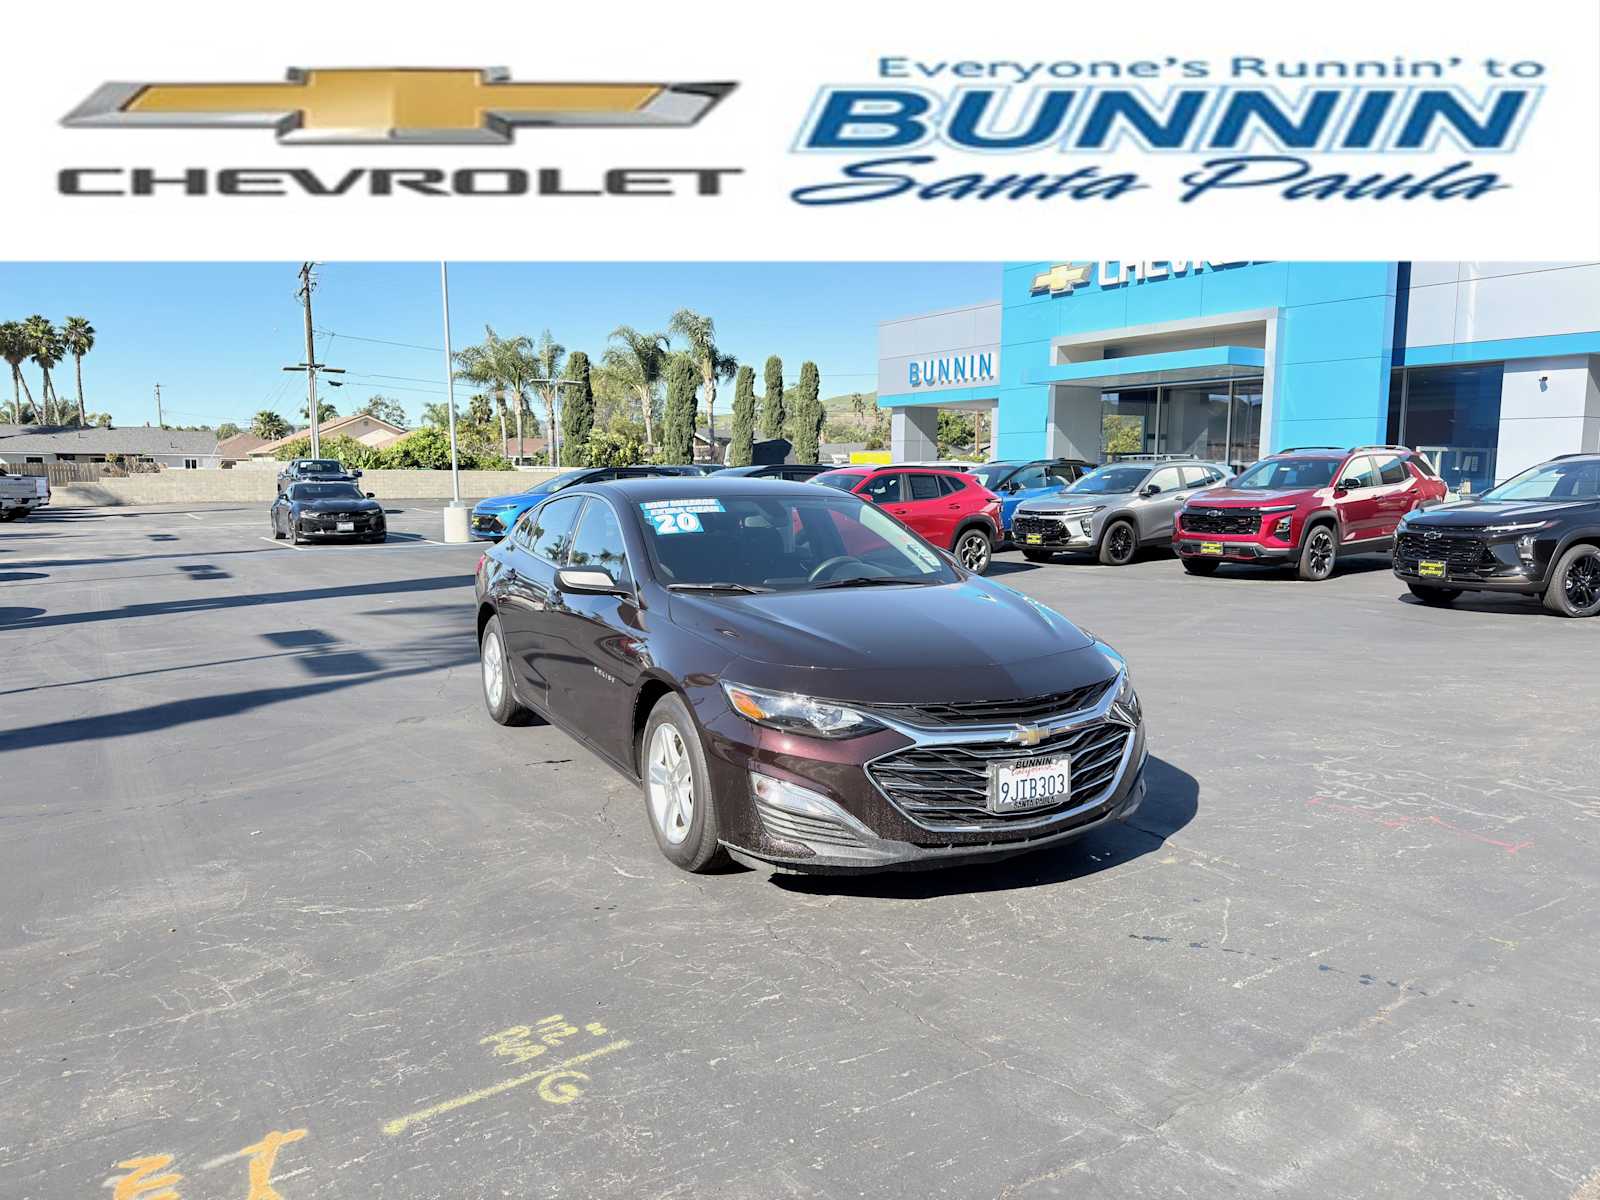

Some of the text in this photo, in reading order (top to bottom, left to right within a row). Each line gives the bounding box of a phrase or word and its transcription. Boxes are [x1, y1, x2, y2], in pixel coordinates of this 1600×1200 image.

[909, 353, 992, 385] BUNNIN
[653, 512, 699, 534] 20
[1015, 757, 1052, 769] BUNNIN
[1000, 773, 1066, 804] 9JIB303
[1013, 799, 1033, 809] SANTA
